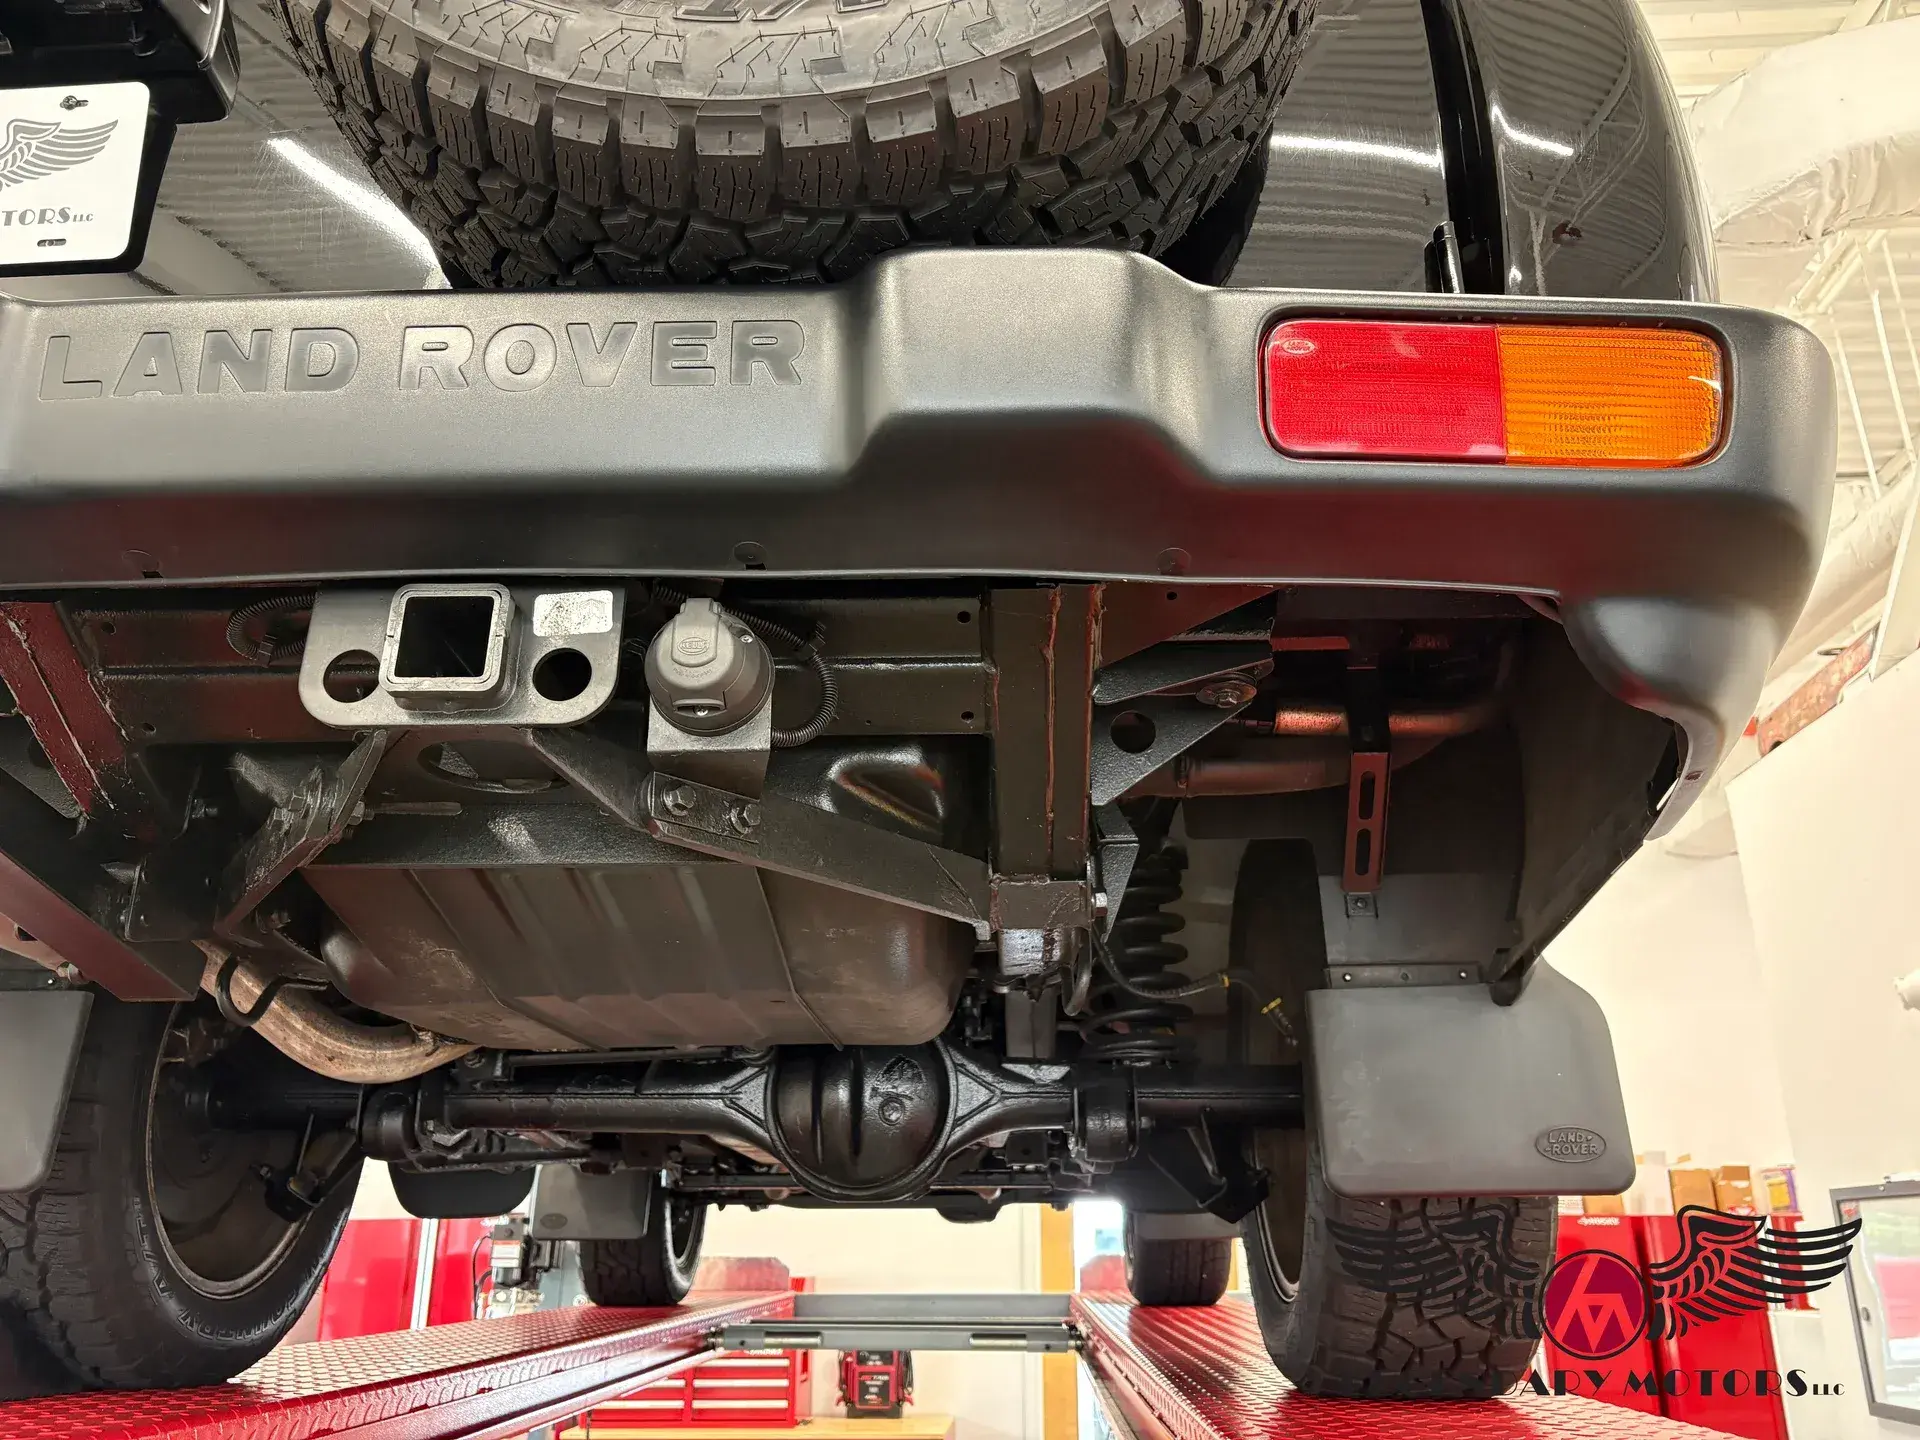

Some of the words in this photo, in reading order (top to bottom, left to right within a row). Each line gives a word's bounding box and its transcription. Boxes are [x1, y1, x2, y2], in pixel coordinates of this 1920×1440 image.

[39, 327, 360, 401] LAND
[399, 320, 805, 392] ROVER
[1547, 1132, 1585, 1143] LAND
[1552, 1143, 1598, 1155] ROVER
